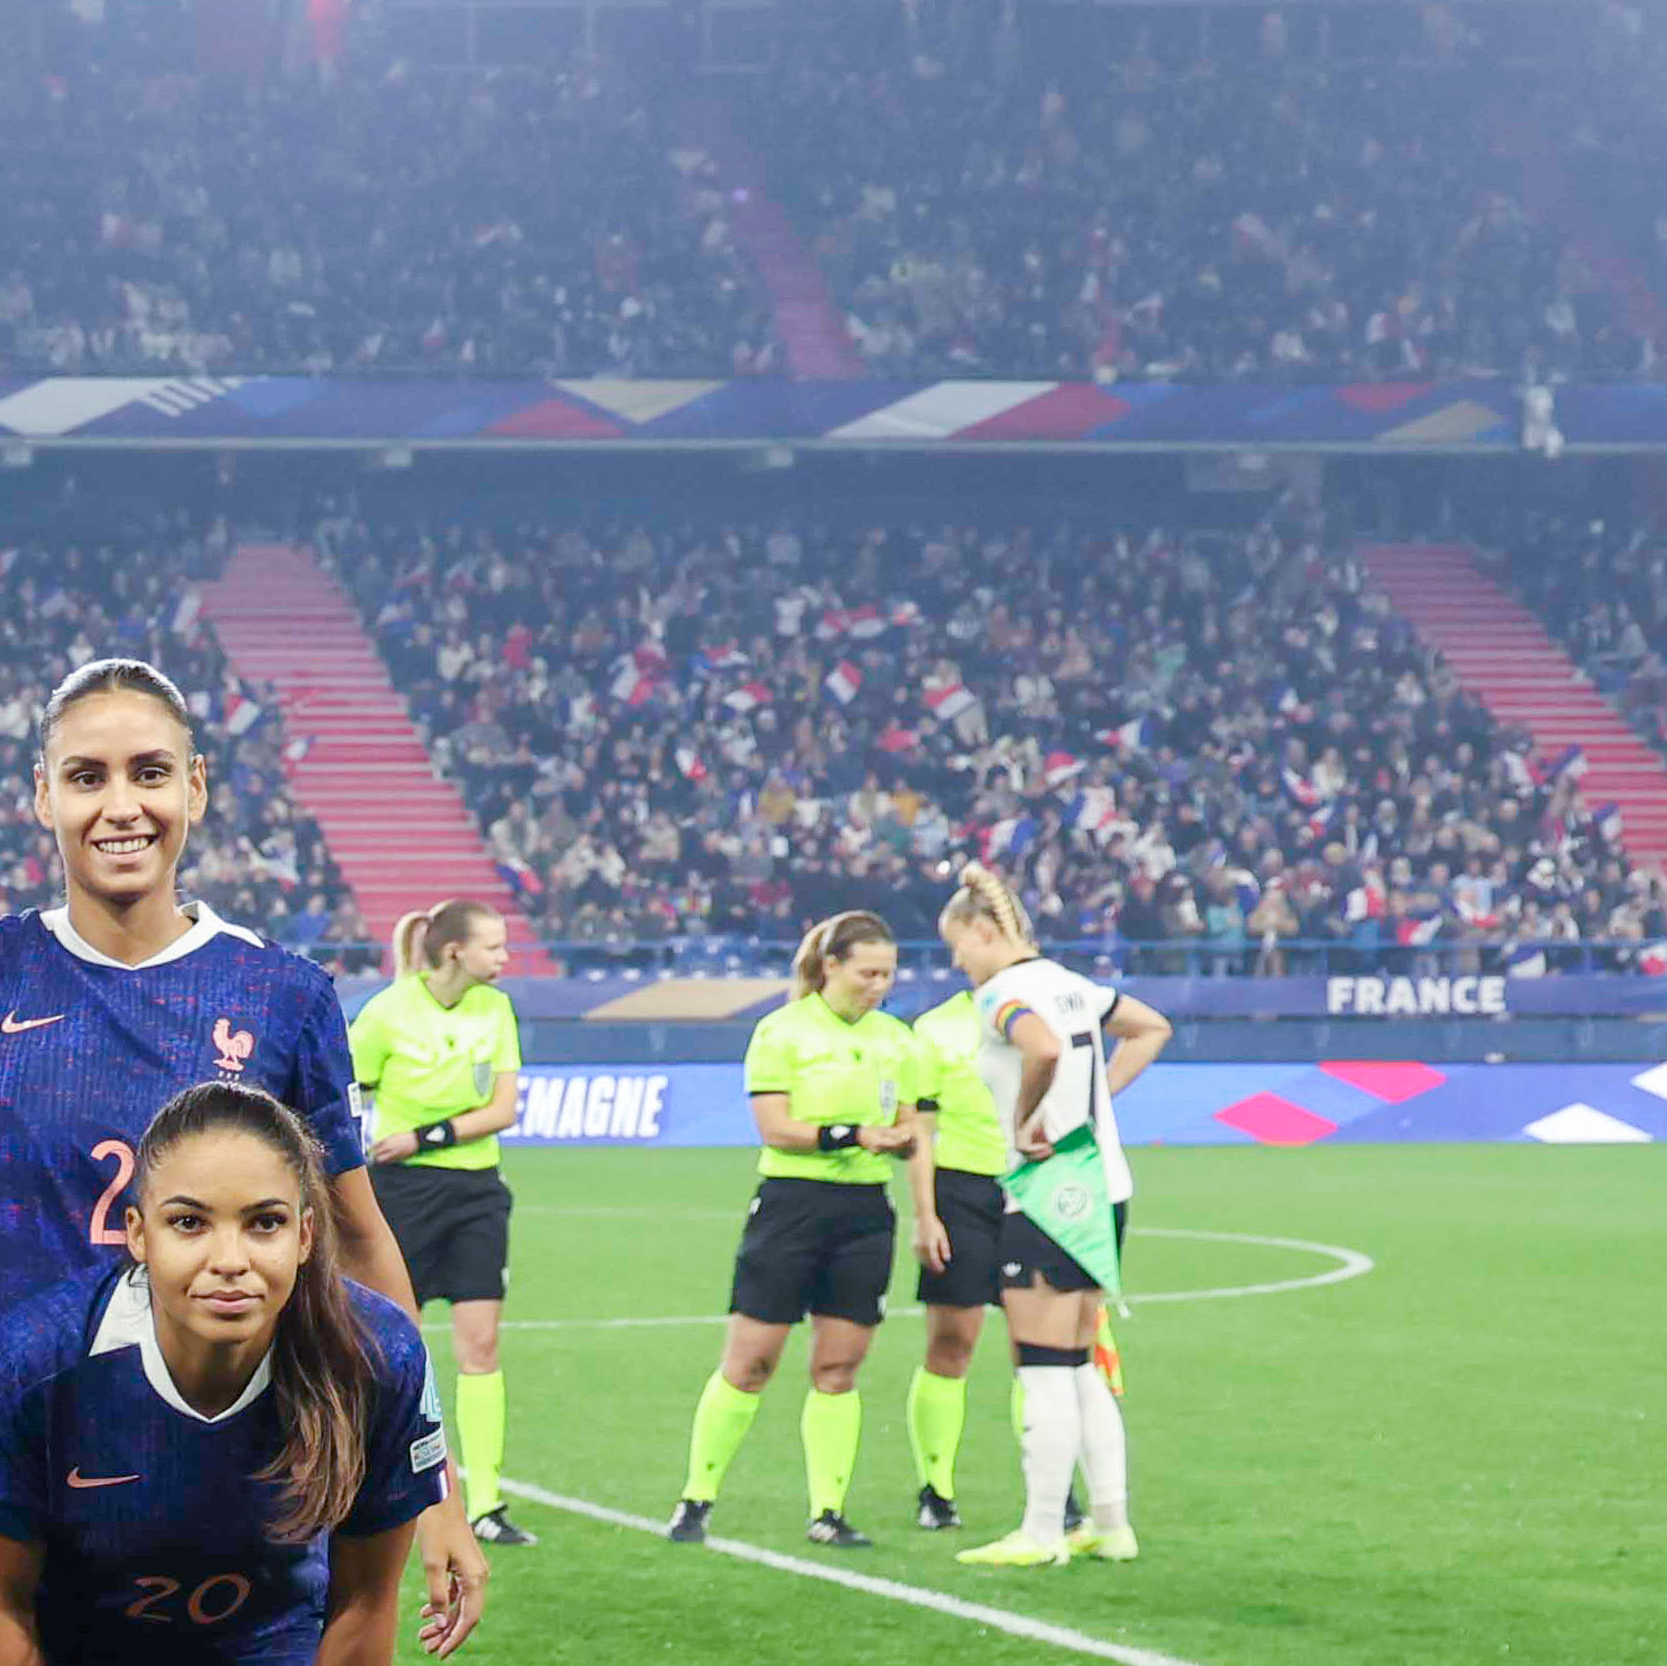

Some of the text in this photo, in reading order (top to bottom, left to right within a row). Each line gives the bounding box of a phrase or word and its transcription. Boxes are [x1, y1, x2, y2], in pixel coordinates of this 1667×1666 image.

[1327, 976, 1506, 1014] FRANCE
[1071, 1031, 1097, 1120] 7
[89, 1139, 135, 1244] 2
[125, 1571, 252, 1624] 20
